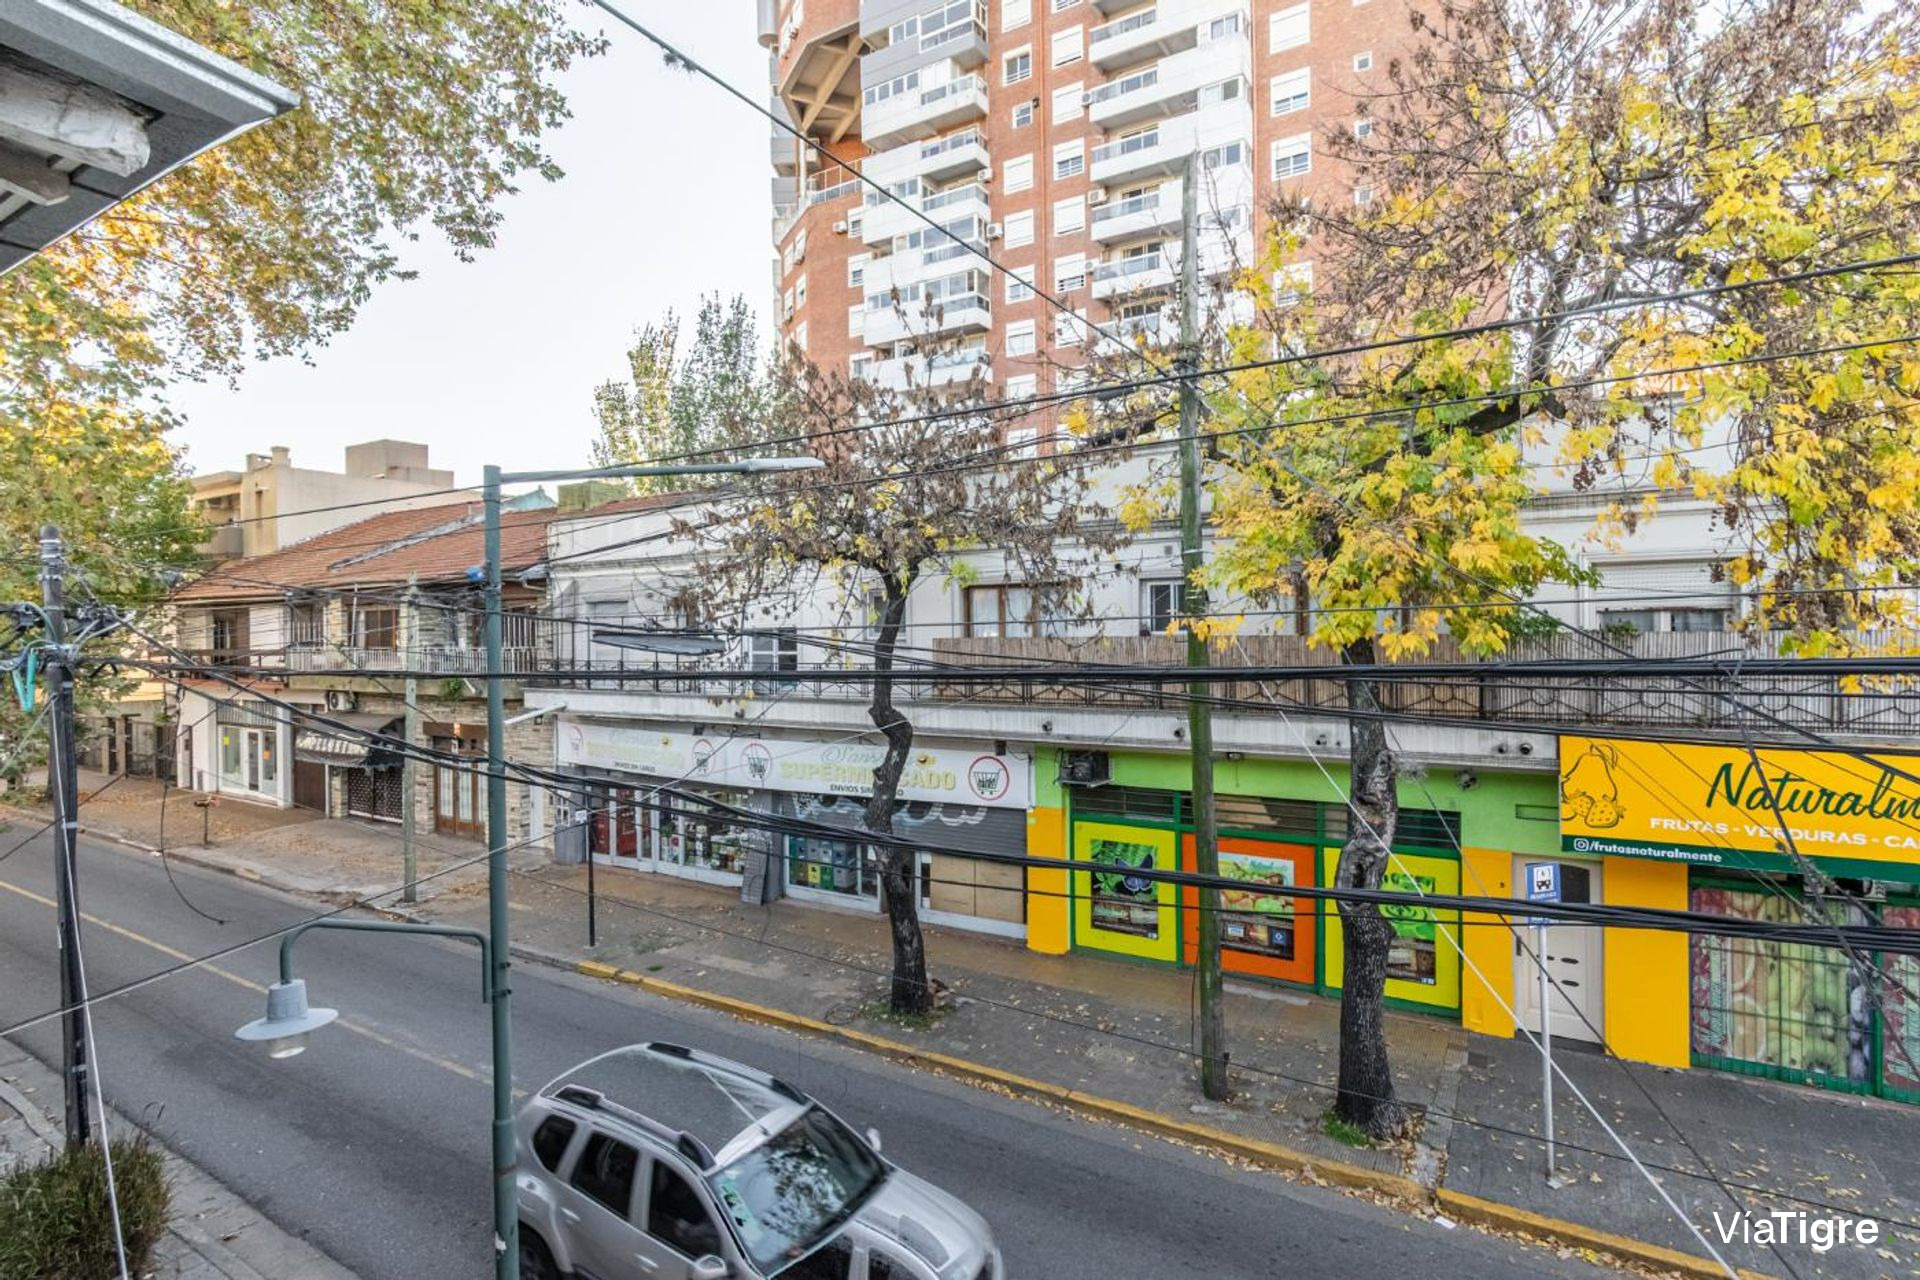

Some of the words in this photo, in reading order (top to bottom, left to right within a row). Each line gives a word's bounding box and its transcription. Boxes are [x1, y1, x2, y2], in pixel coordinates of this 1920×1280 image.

[1649, 817, 1730, 834] FRUTAS
[1744, 824, 1867, 846] VERDURAS
[1883, 835, 1920, 850] CA
